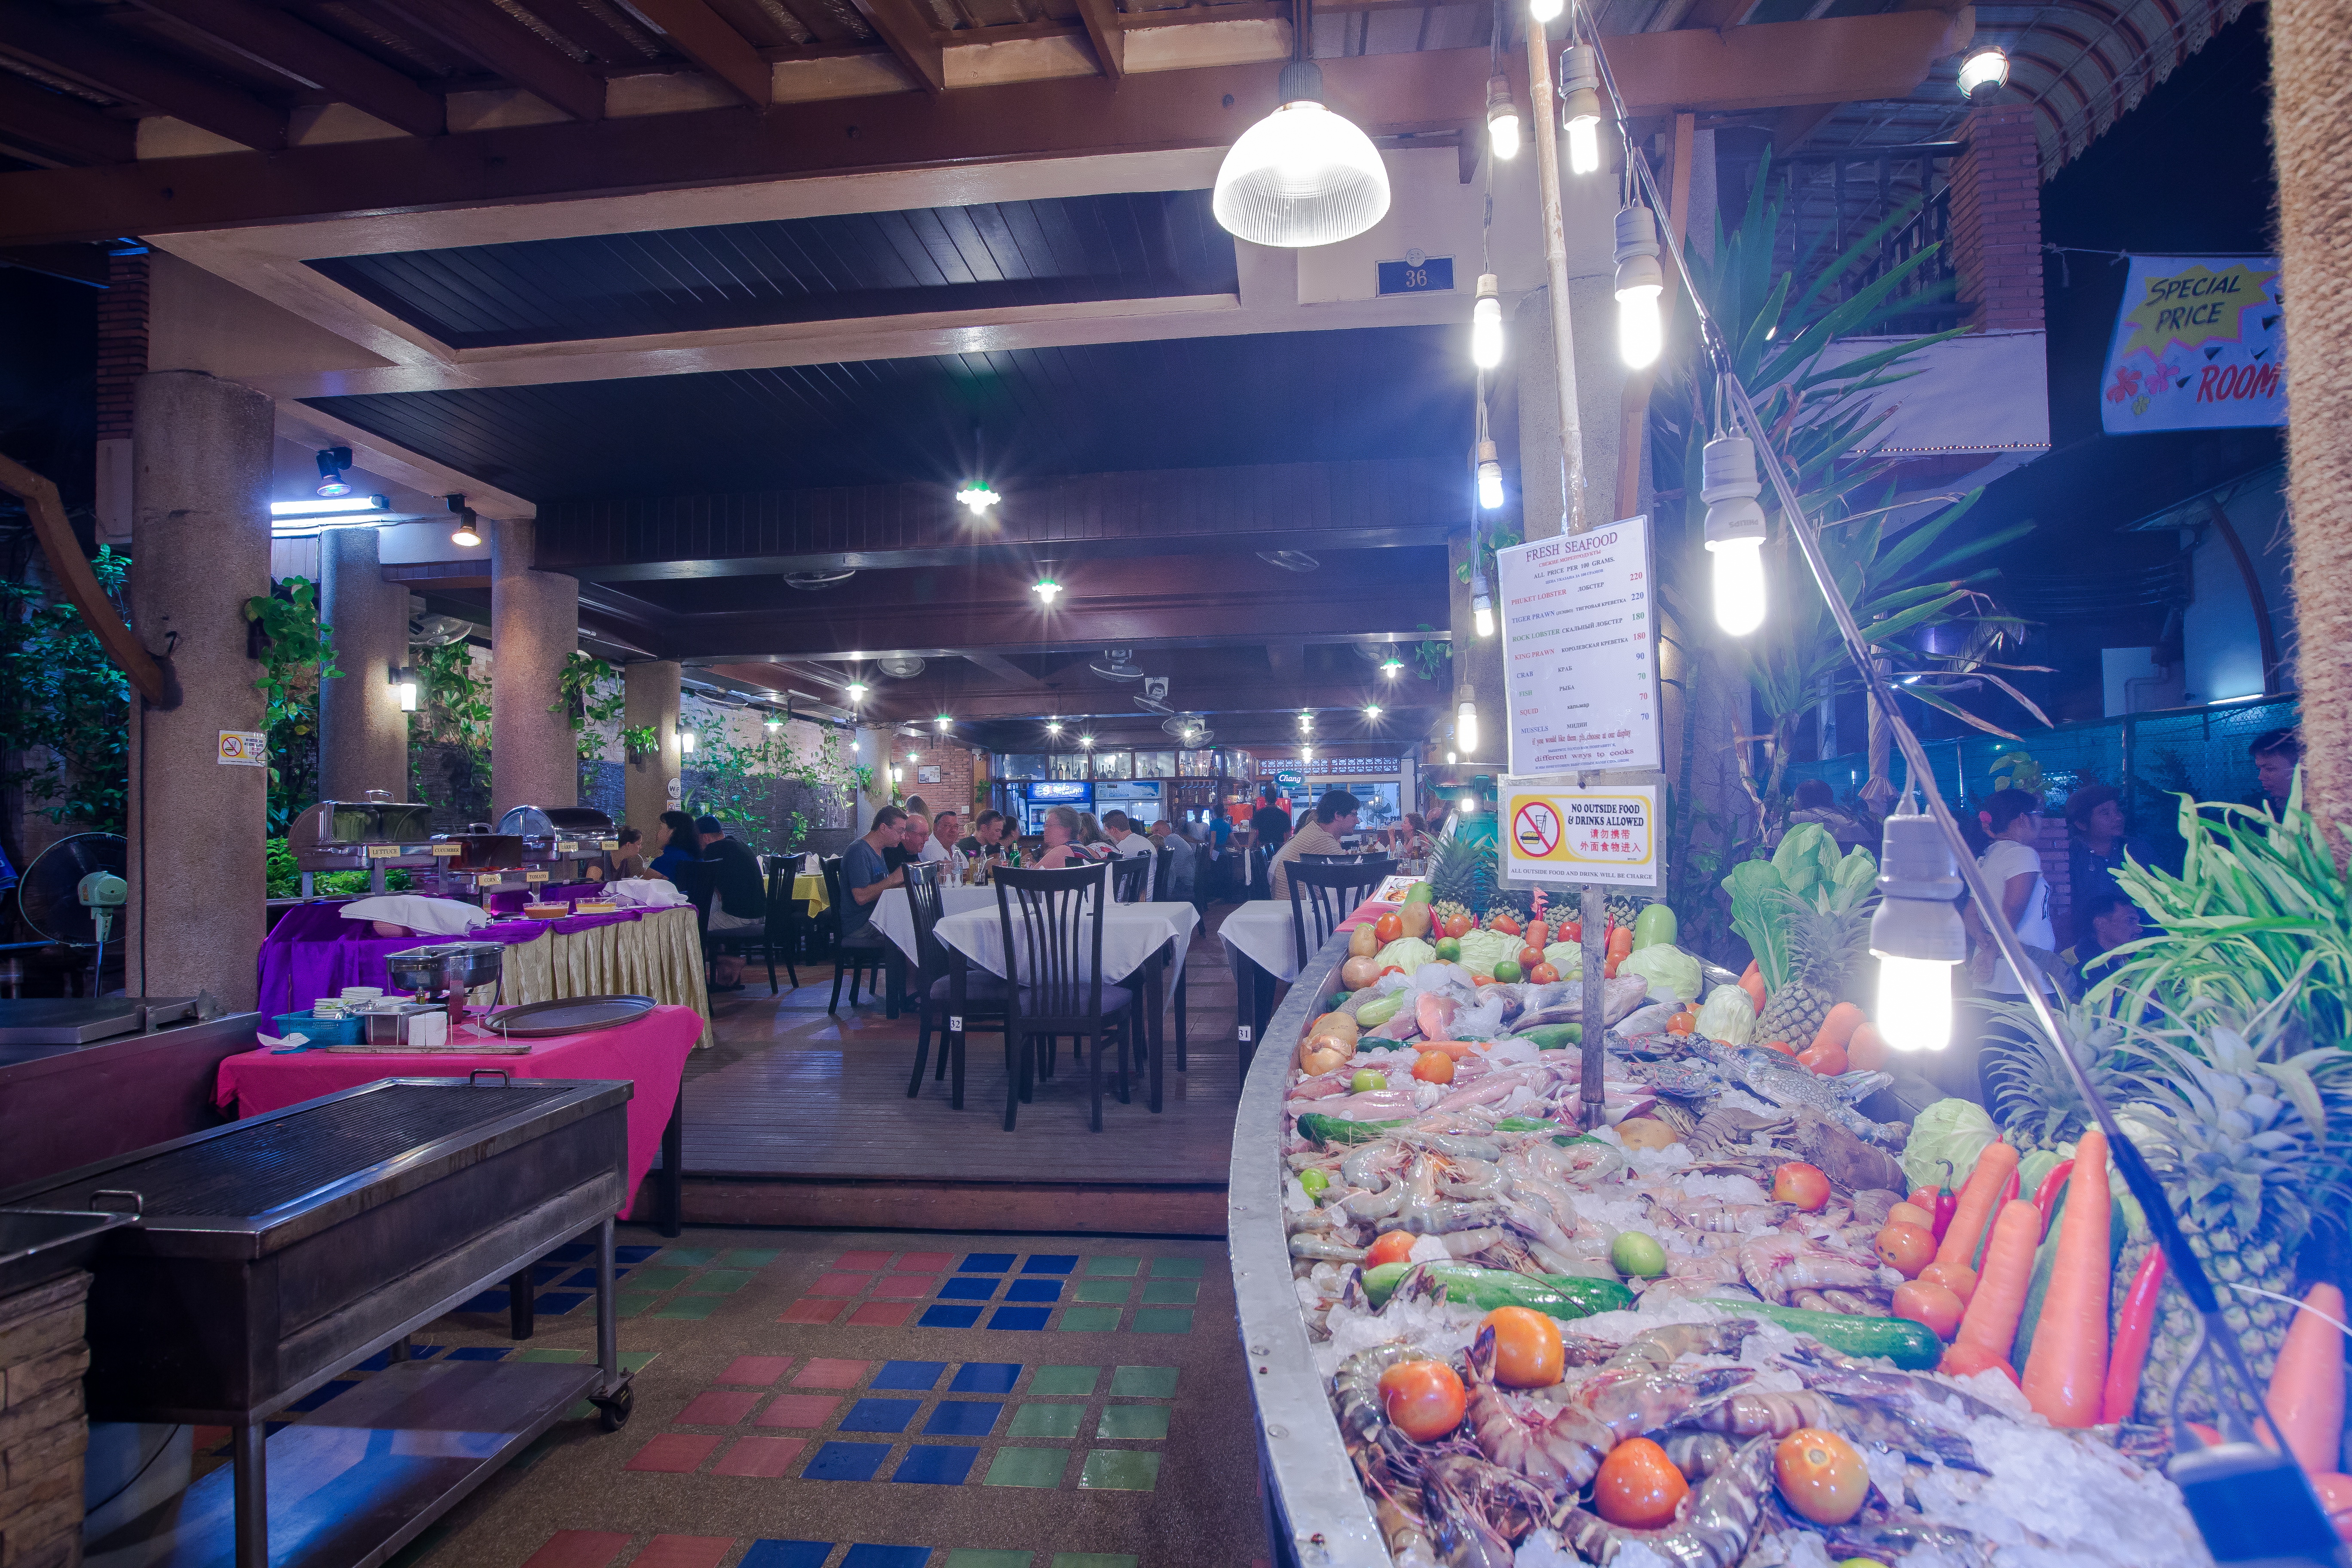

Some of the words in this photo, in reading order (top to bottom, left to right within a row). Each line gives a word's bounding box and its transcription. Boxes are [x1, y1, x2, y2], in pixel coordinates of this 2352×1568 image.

[1406, 269, 1427, 288] 36
[2146, 274, 2242, 306] SPECIAL
[2155, 301, 2225, 332] PRICE
[2196, 362, 2282, 404] ROOM
[1526, 543, 1560, 563] FRESH
[1565, 532, 1618, 553] SEAFOOD
[1560, 550, 1601, 563] МОРЕПРОДУКТЫ
[1547, 568, 1564, 576] PRICE
[1592, 557, 1615, 566] GRAMS.
[1511, 595, 1536, 606] PHUKET
[1537, 589, 1567, 600] LOBSTER
[1577, 582, 1604, 592] ЛОБСТЕР
[1630, 572, 1642, 581] 220
[1512, 615, 1531, 623] TIGER
[1532, 610, 1555, 620] PRAWN
[1575, 603, 1601, 612] ТИГРОВАЯ
[1602, 598, 1626, 607] КРЕВЕТКА
[1631, 591, 1644, 601] 220
[1531, 628, 1560, 639] LOBSTER
[1562, 622, 1594, 633] СКАЛЬНЫЙ
[1596, 618, 1623, 628] ЛОБСТЕР
[1632, 612, 1645, 621] 180
[1532, 649, 1555, 658] PRAWN
[1562, 642, 1599, 653] КОРОЛЕВСКАЯ
[1601, 638, 1628, 646] КРЕВЕТКА
[1633, 632, 1645, 640] 180
[1636, 652, 1645, 661] 90
[1521, 726, 1548, 734] MUSSELS
[1617, 729, 1631, 738] display
[1535, 754, 1568, 762] different
[1279, 774, 1301, 784] Chang
[1571, 803, 1582, 813] NO
[1584, 804, 1617, 814] OUTSIDE
[1619, 804, 1640, 814] FOOD
[1568, 816, 1574, 824] &
[1575, 816, 1604, 826] DRINKS
[1606, 817, 1644, 827] ALLOWED
[1590, 829, 1630, 839] 请勿携带
[1580, 841, 1641, 852] 外面食物进入
[951, 1020, 960, 1028] 32
